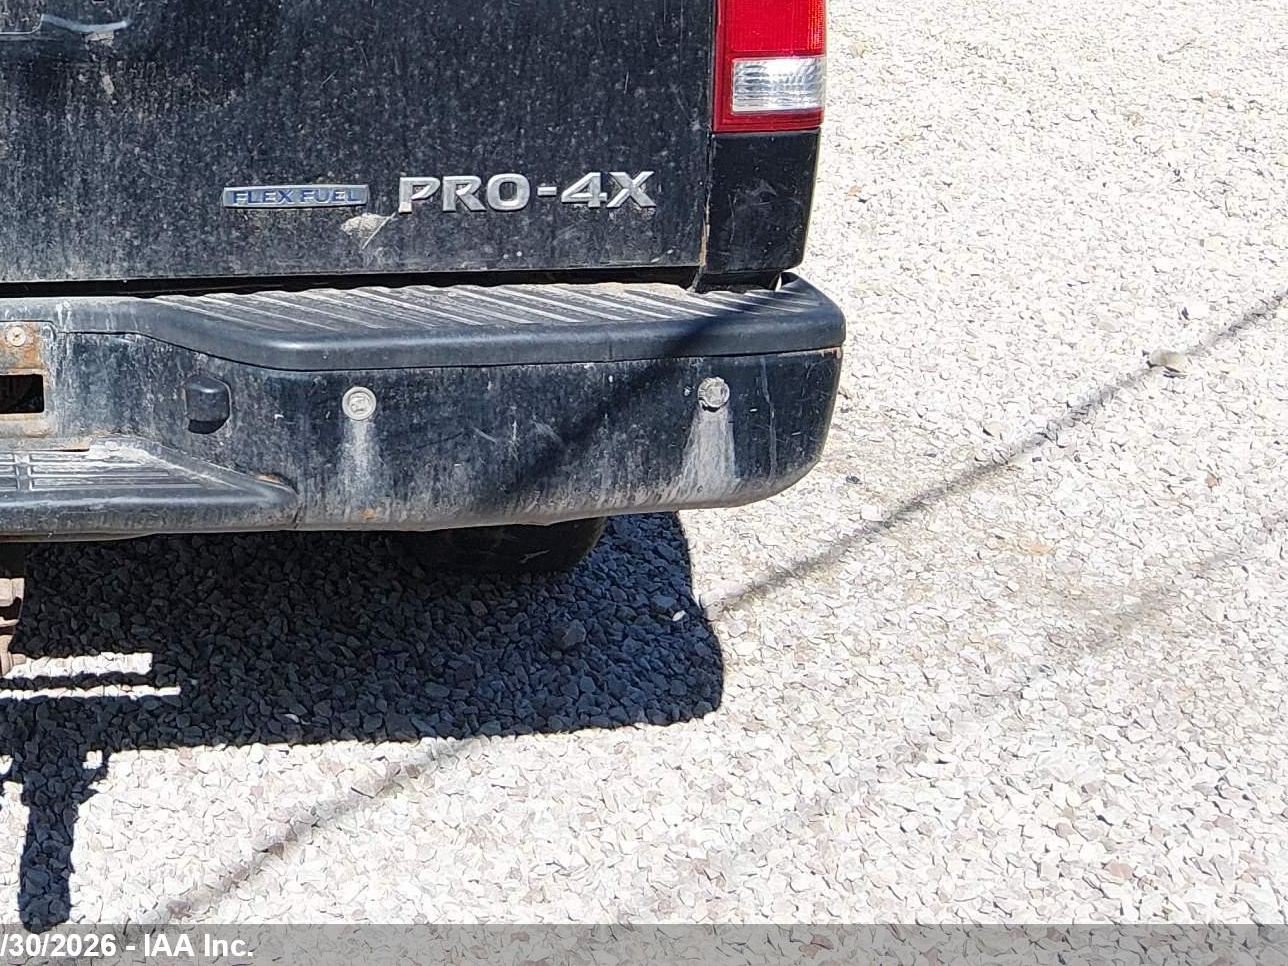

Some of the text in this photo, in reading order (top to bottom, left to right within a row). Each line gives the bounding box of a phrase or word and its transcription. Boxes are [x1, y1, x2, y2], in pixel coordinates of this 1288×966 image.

[232, 188, 360, 206] FLEX FUEL
[398, 170, 657, 213] PRO-4X
